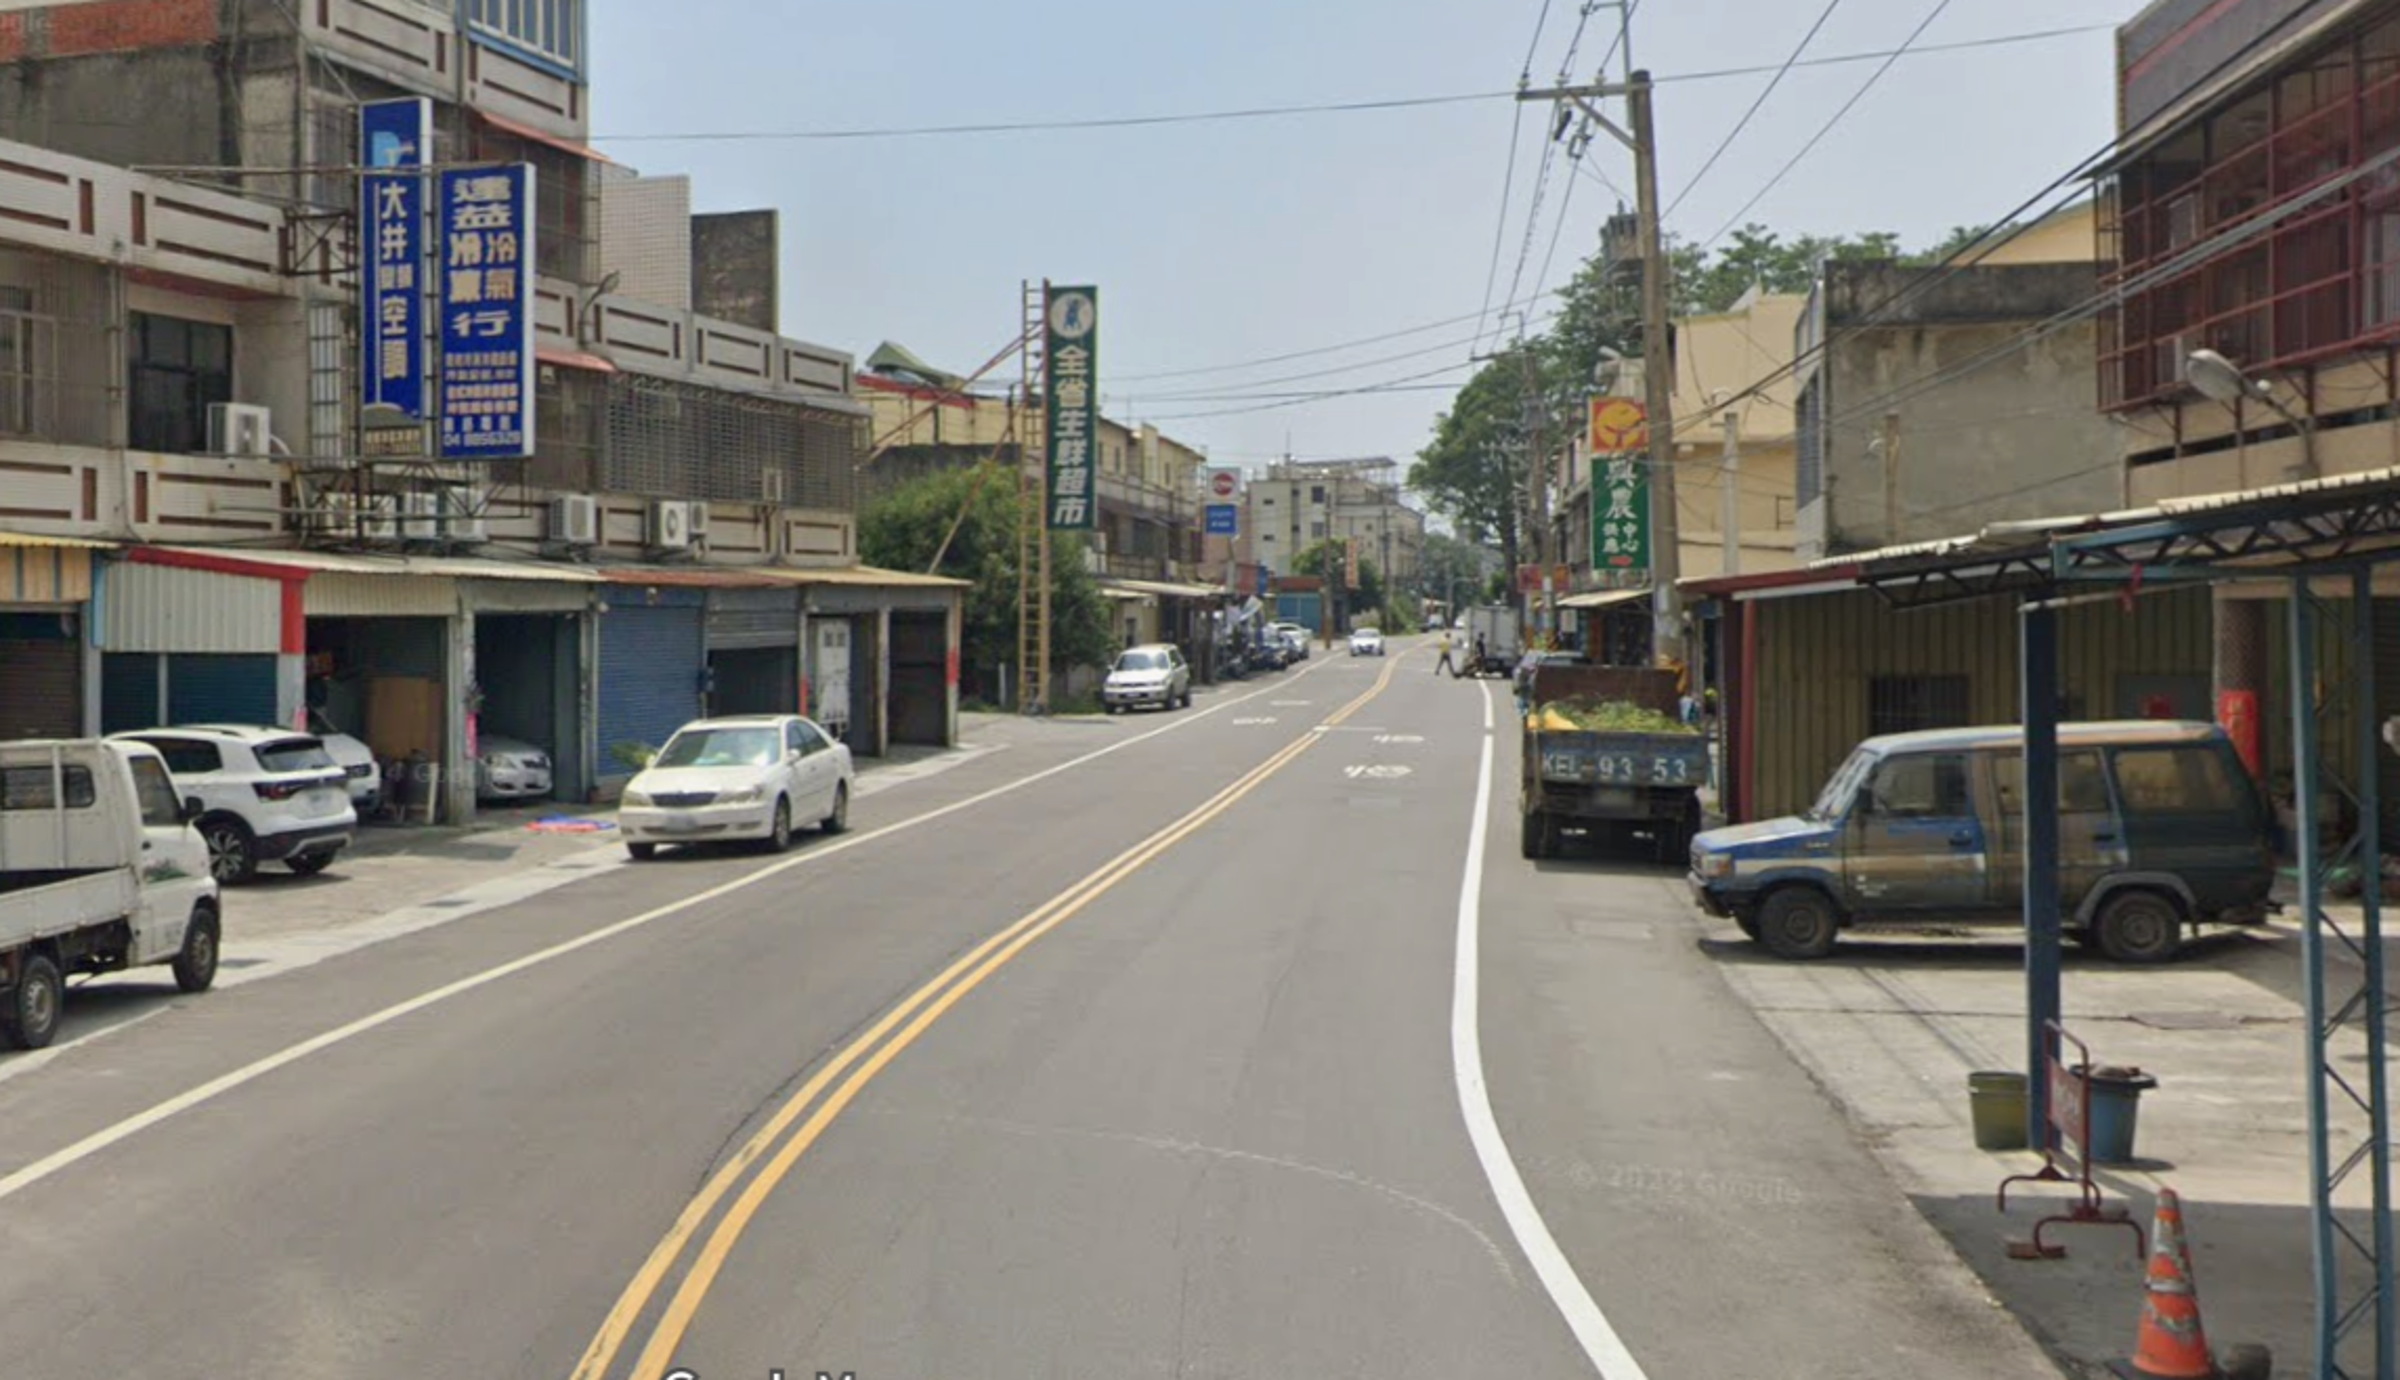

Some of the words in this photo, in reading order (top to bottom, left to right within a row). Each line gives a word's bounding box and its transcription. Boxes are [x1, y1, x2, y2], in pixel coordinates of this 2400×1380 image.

[1053, 343, 1091, 526] 全省生鮮超市
